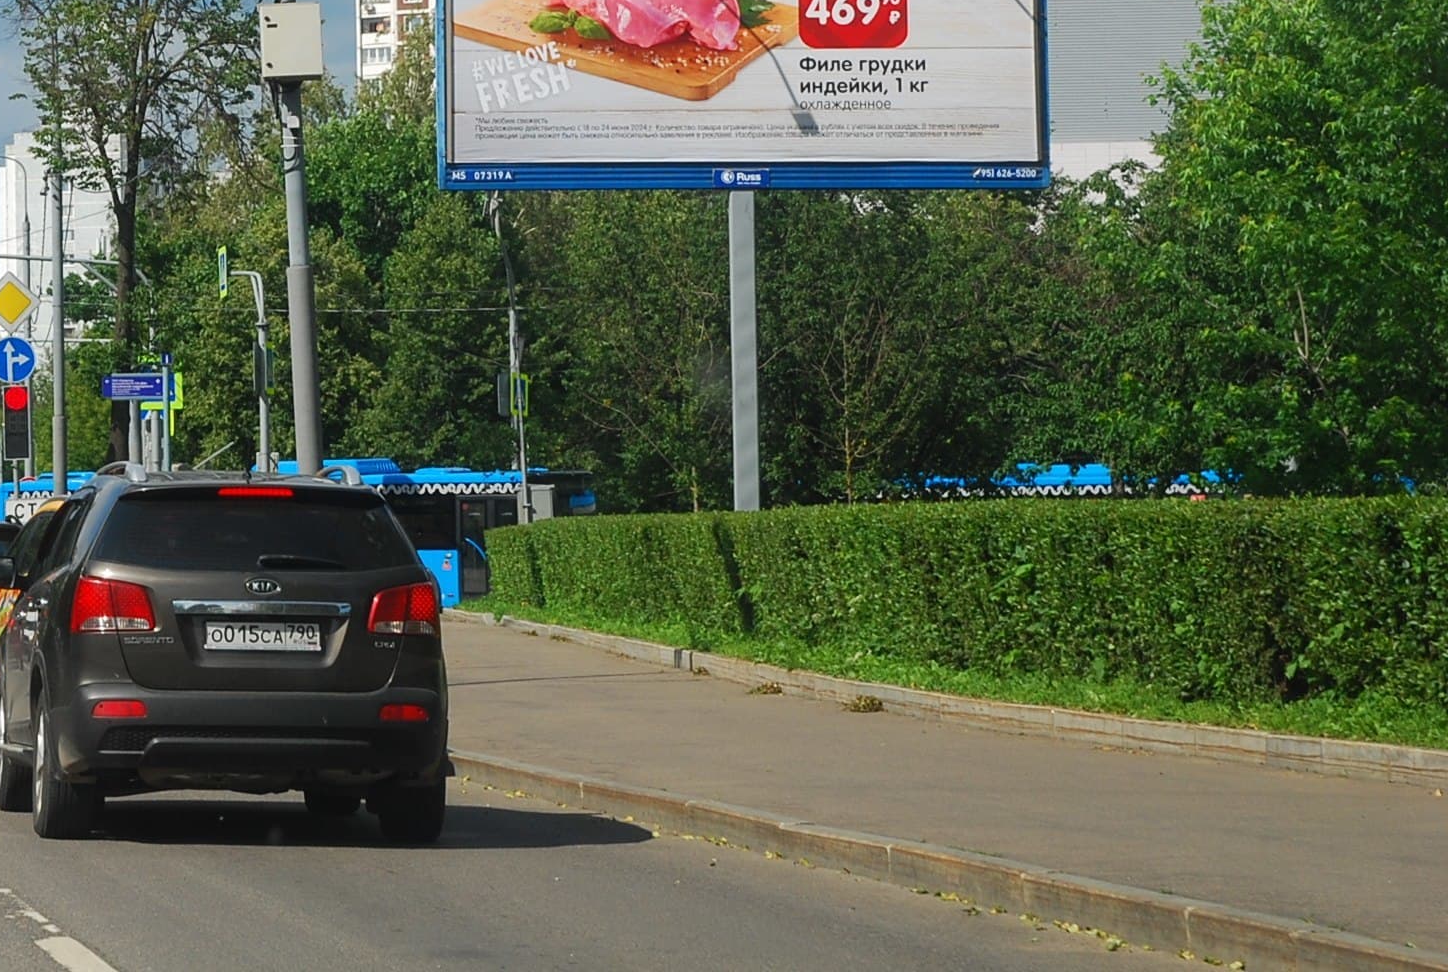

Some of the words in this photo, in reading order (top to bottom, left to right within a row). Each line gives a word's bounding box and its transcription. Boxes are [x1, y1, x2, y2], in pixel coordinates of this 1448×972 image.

[472, 53, 515, 81] #WE
[516, 41, 560, 69] LOVE
[799, 56, 853, 72] Филе
[859, 59, 926, 75] грудки
[800, 77, 889, 96] индейки,
[895, 77, 902, 93] 1
[910, 80, 929, 93] кг
[800, 99, 892, 111] охлажденное
[736, 172, 762, 181] Russ
[996, 168, 1036, 178] 626-5200
[14, 502, 37, 519] СТ
[252, 581, 274, 592] KIA
[211, 624, 283, 643] О015СА
[287, 625, 315, 639] 790
